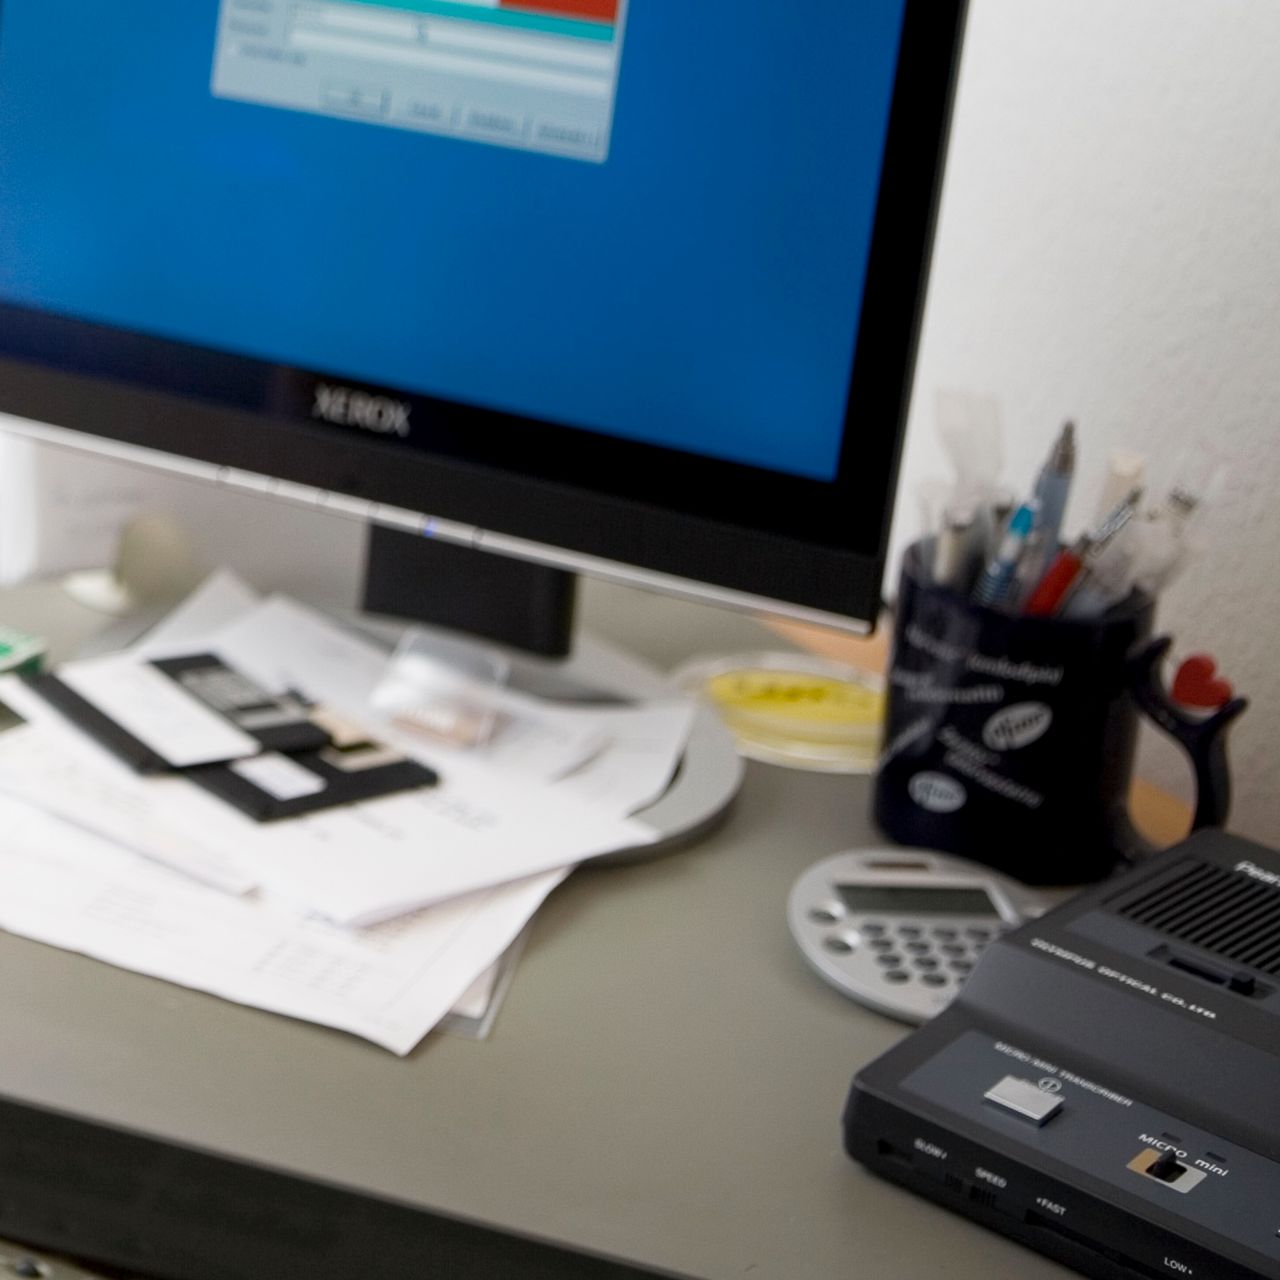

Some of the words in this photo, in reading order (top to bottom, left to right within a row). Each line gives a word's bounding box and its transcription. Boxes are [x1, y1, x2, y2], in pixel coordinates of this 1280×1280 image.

[313, 383, 411, 437] XEROX
[1031, 937, 1096, 969] OLYMPUS
[1098, 966, 1157, 995] OPTICAL
[975, 1166, 1007, 1189] SPEED
[1194, 1158, 1229, 1177] mini
[1042, 1197, 1067, 1216] FAST
[1164, 1257, 1187, 1273] LOW
